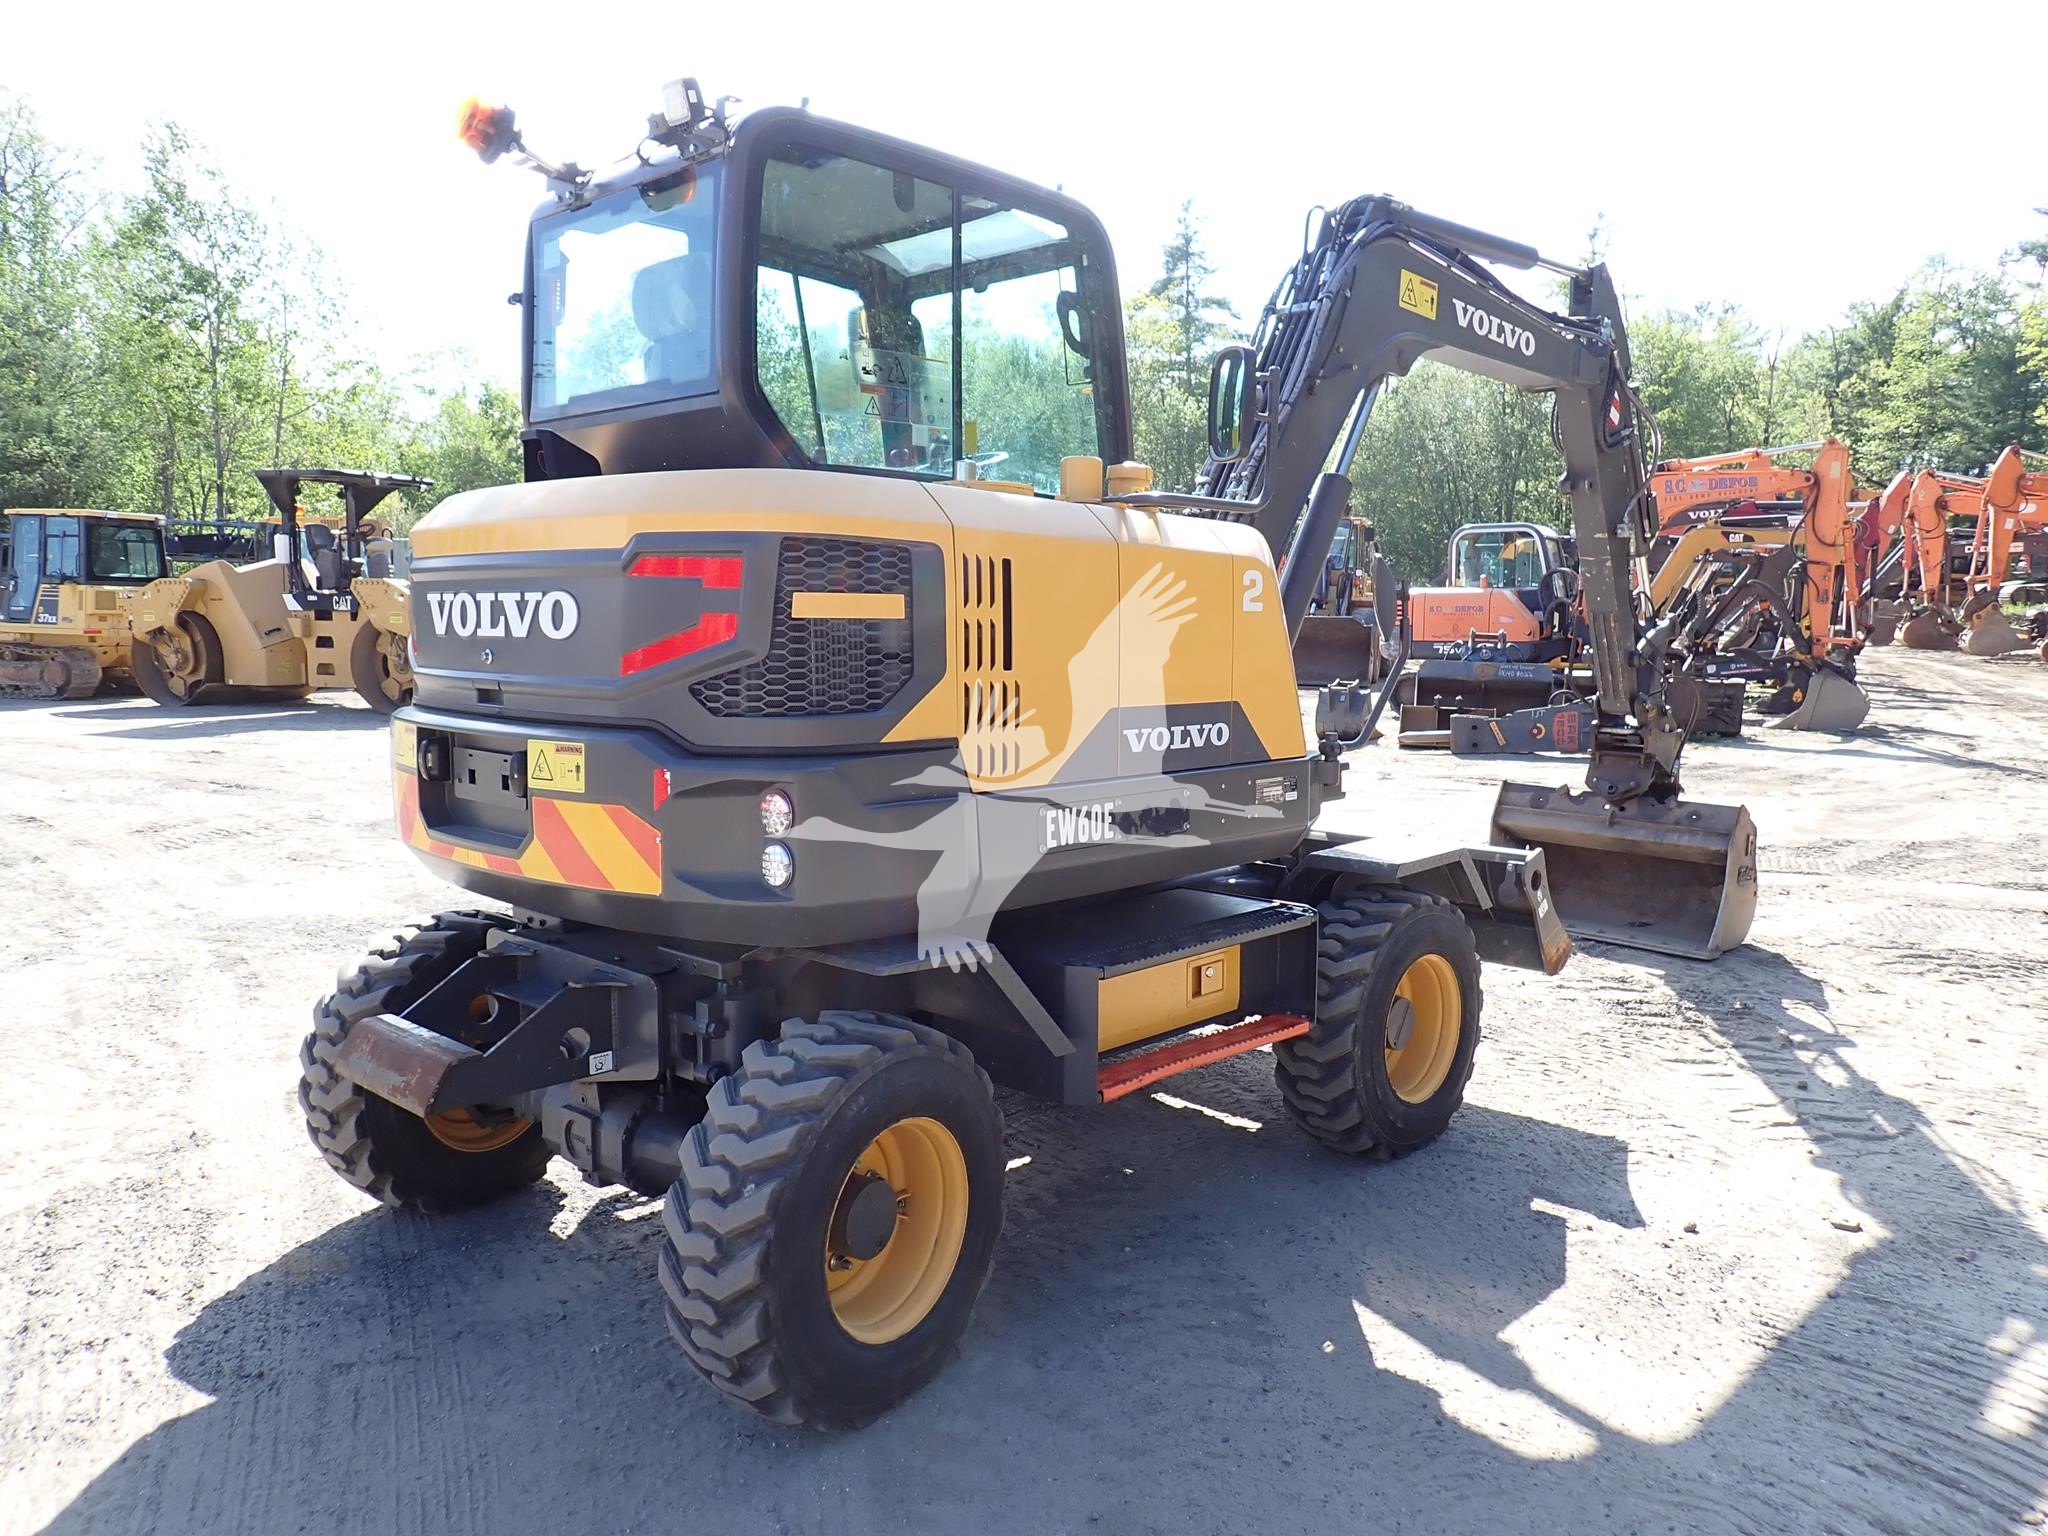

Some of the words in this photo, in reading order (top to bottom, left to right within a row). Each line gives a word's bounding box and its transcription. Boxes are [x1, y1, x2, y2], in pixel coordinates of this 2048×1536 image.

[1452, 298, 1536, 356] VOLVO
[1729, 533, 1744, 543] CAT
[332, 595, 352, 611] CAT
[1242, 569, 1264, 612] 2
[426, 590, 580, 640] VOLVO
[1123, 722, 1230, 753] VOLVO
[1046, 802, 1115, 849] EW60E
